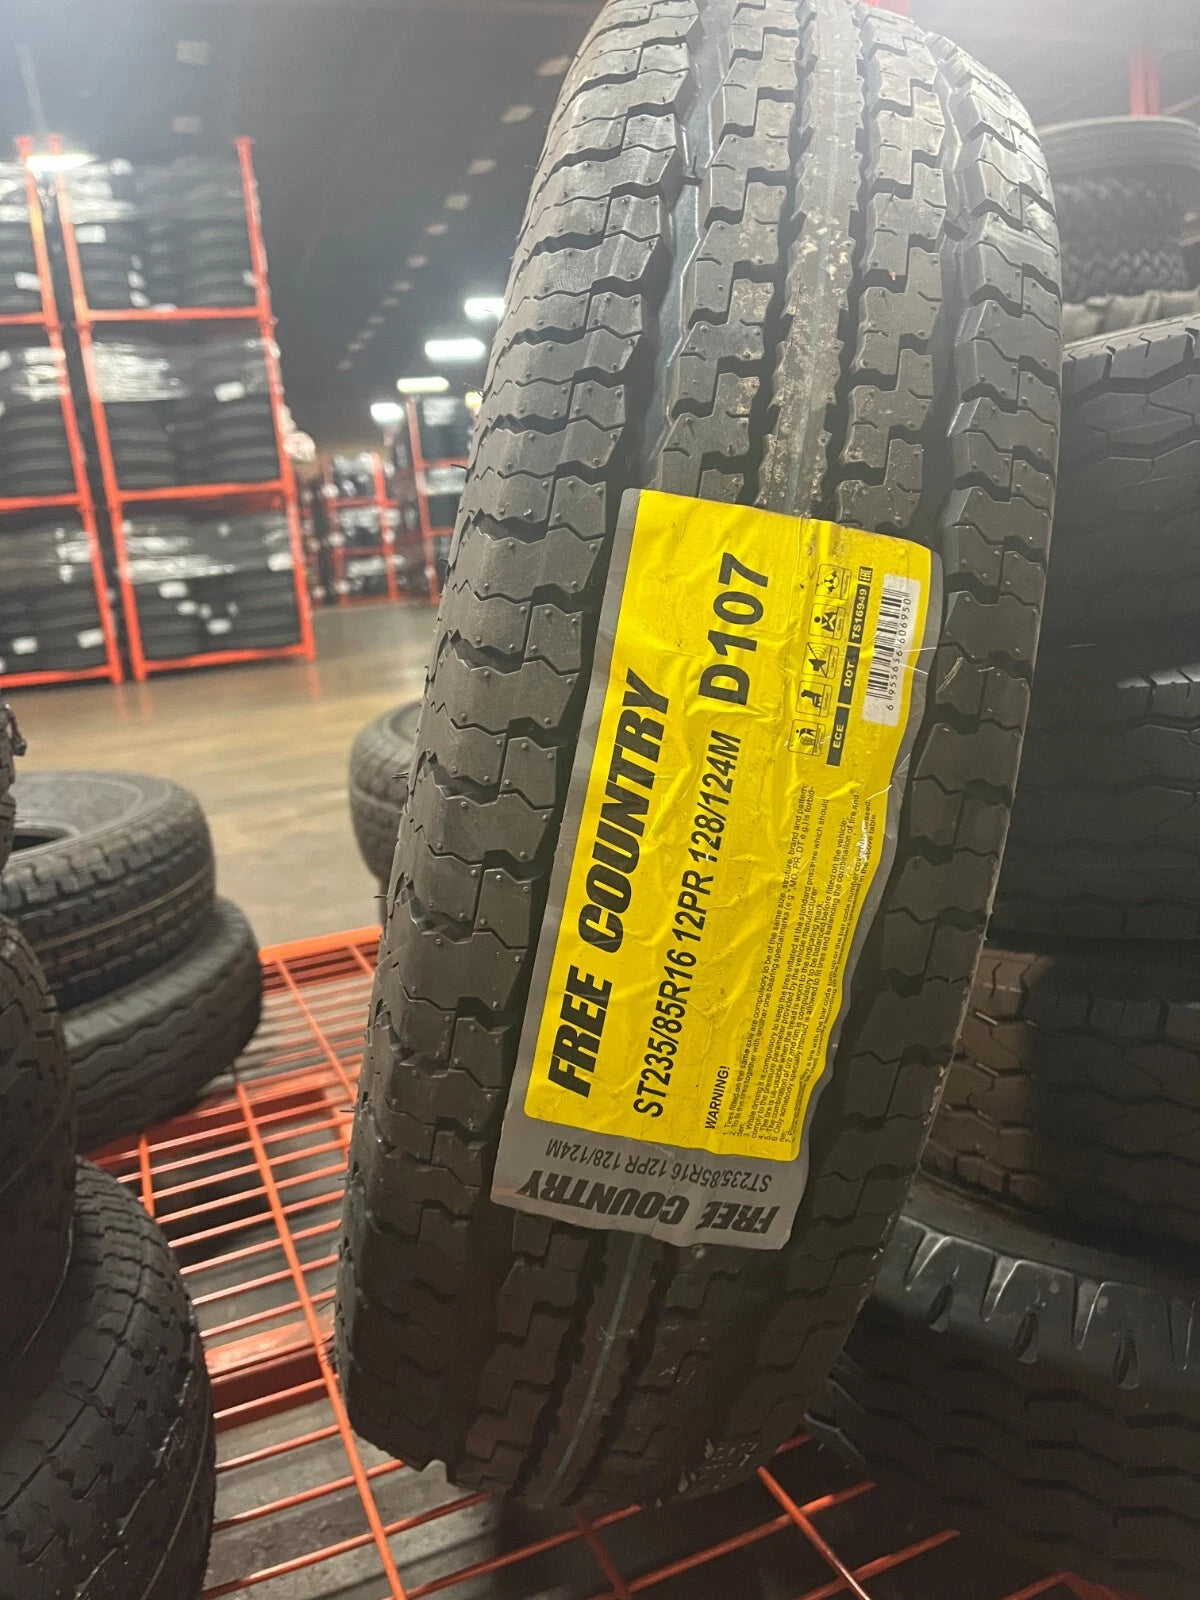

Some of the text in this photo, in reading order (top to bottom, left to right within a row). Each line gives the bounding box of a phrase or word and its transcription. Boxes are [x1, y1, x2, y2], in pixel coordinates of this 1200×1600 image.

[698, 553, 768, 706] D107
[885, 703, 894, 711] 6
[896, 597, 911, 644] 606950
[833, 725, 844, 748] ECE
[844, 662, 854, 686] DOT
[852, 589, 867, 639] TS16949
[850, 794, 859, 809] and
[817, 798, 828, 824] should
[847, 810, 856, 824] tire
[792, 814, 802, 830] and
[845, 825, 853, 833] of
[787, 831, 798, 855] brand
[796, 840, 804, 852] DT
[812, 825, 823, 849] which
[832, 848, 841, 862] the
[836, 834, 851, 882] combination
[831, 862, 838, 873] on
[858, 861, 868, 873] the
[548, 668, 668, 1098] FREE COUNTRY
[826, 874, 836, 894] fitted
[832, 883, 842, 896] the
[844, 872, 858, 902] number
[796, 886, 810, 920] standard
[820, 895, 831, 920] before
[839, 902, 850, 921] code
[633, 730, 741, 1117] ST235/85R16 12PR 128/124M
[772, 909, 782, 931] same
[777, 911, 789, 934] marks
[823, 897, 839, 935] balancing
[793, 921, 802, 934] the
[836, 922, 845, 935] bar
[768, 931, 777, 944] the
[791, 934, 799, 942] at
[803, 923, 819, 959] indicating
[811, 921, 825, 956] balanced
[820, 936, 829, 951] and
[832, 936, 842, 949] the
[766, 944, 774, 953] of
[771, 934, 785, 962] special
[784, 943, 797, 971] inflated
[793, 939, 805, 966] vehicle
[763, 954, 772, 964] be
[800, 960, 809, 973] the
[808, 957, 817, 967] be
[816, 951, 826, 968] tires
[762, 965, 769, 973] to
[765, 962, 779, 992] bearing
[790, 967, 799, 980] the
[797, 973, 806, 982] to
[806, 968, 814, 976] to
[814, 968, 822, 976] fit
[780, 973, 790, 989] tires
[788, 980, 797, 990] by
[811, 977, 819, 985] to
[752, 974, 769, 1018] compulsory
[763, 993, 771, 1007] one
[777, 990, 786, 1002] the
[794, 983, 803, 1001] worn
[796, 977, 813, 1020] compulsory
[804, 986, 817, 1015] allowed
[820, 986, 831, 1006] code
[772, 1003, 784, 1022] keep
[780, 991, 795, 1024] provided
[770, 1022, 778, 1030] to
[786, 1010, 797, 1029] tread
[813, 1019, 822, 1032] the
[783, 1030, 792, 1042] the
[790, 1027, 800, 1040] rim
[795, 1023, 808, 1049] trained
[809, 1033, 819, 1048] with
[750, 1037, 759, 1052] with
[760, 1032, 777, 1073] compulsory
[770, 1025, 787, 1062] parameter
[787, 1041, 796, 1056] and
[740, 1048, 750, 1069] same
[777, 1043, 789, 1063] when
[784, 1056, 793, 1069] tire
[787, 1051, 802, 1081] specially
[763, 1063, 777, 1093] pressure
[781, 1069, 790, 1077] of
[705, 1066, 728, 1129] WARNING!
[749, 1086, 763, 1109] driving
[758, 1094, 768, 1105] the
[769, 1078, 787, 1118] combination
[777, 1083, 794, 1117] somebody
[756, 1106, 764, 1114] to
[762, 1105, 772, 1117] tire
[723, 1111, 734, 1129] Tires
[730, 1119, 738, 1128] To
[744, 1110, 755, 1130] While
[749, 1114, 763, 1138] comply
[758, 1117, 768, 1131] The
[765, 1118, 775, 1132] The
[772, 1117, 784, 1133] Only
[545, 1139, 772, 1192] ST235/85R16 12PR 128/124M
[516, 1170, 780, 1233] FREE COUNTRY
